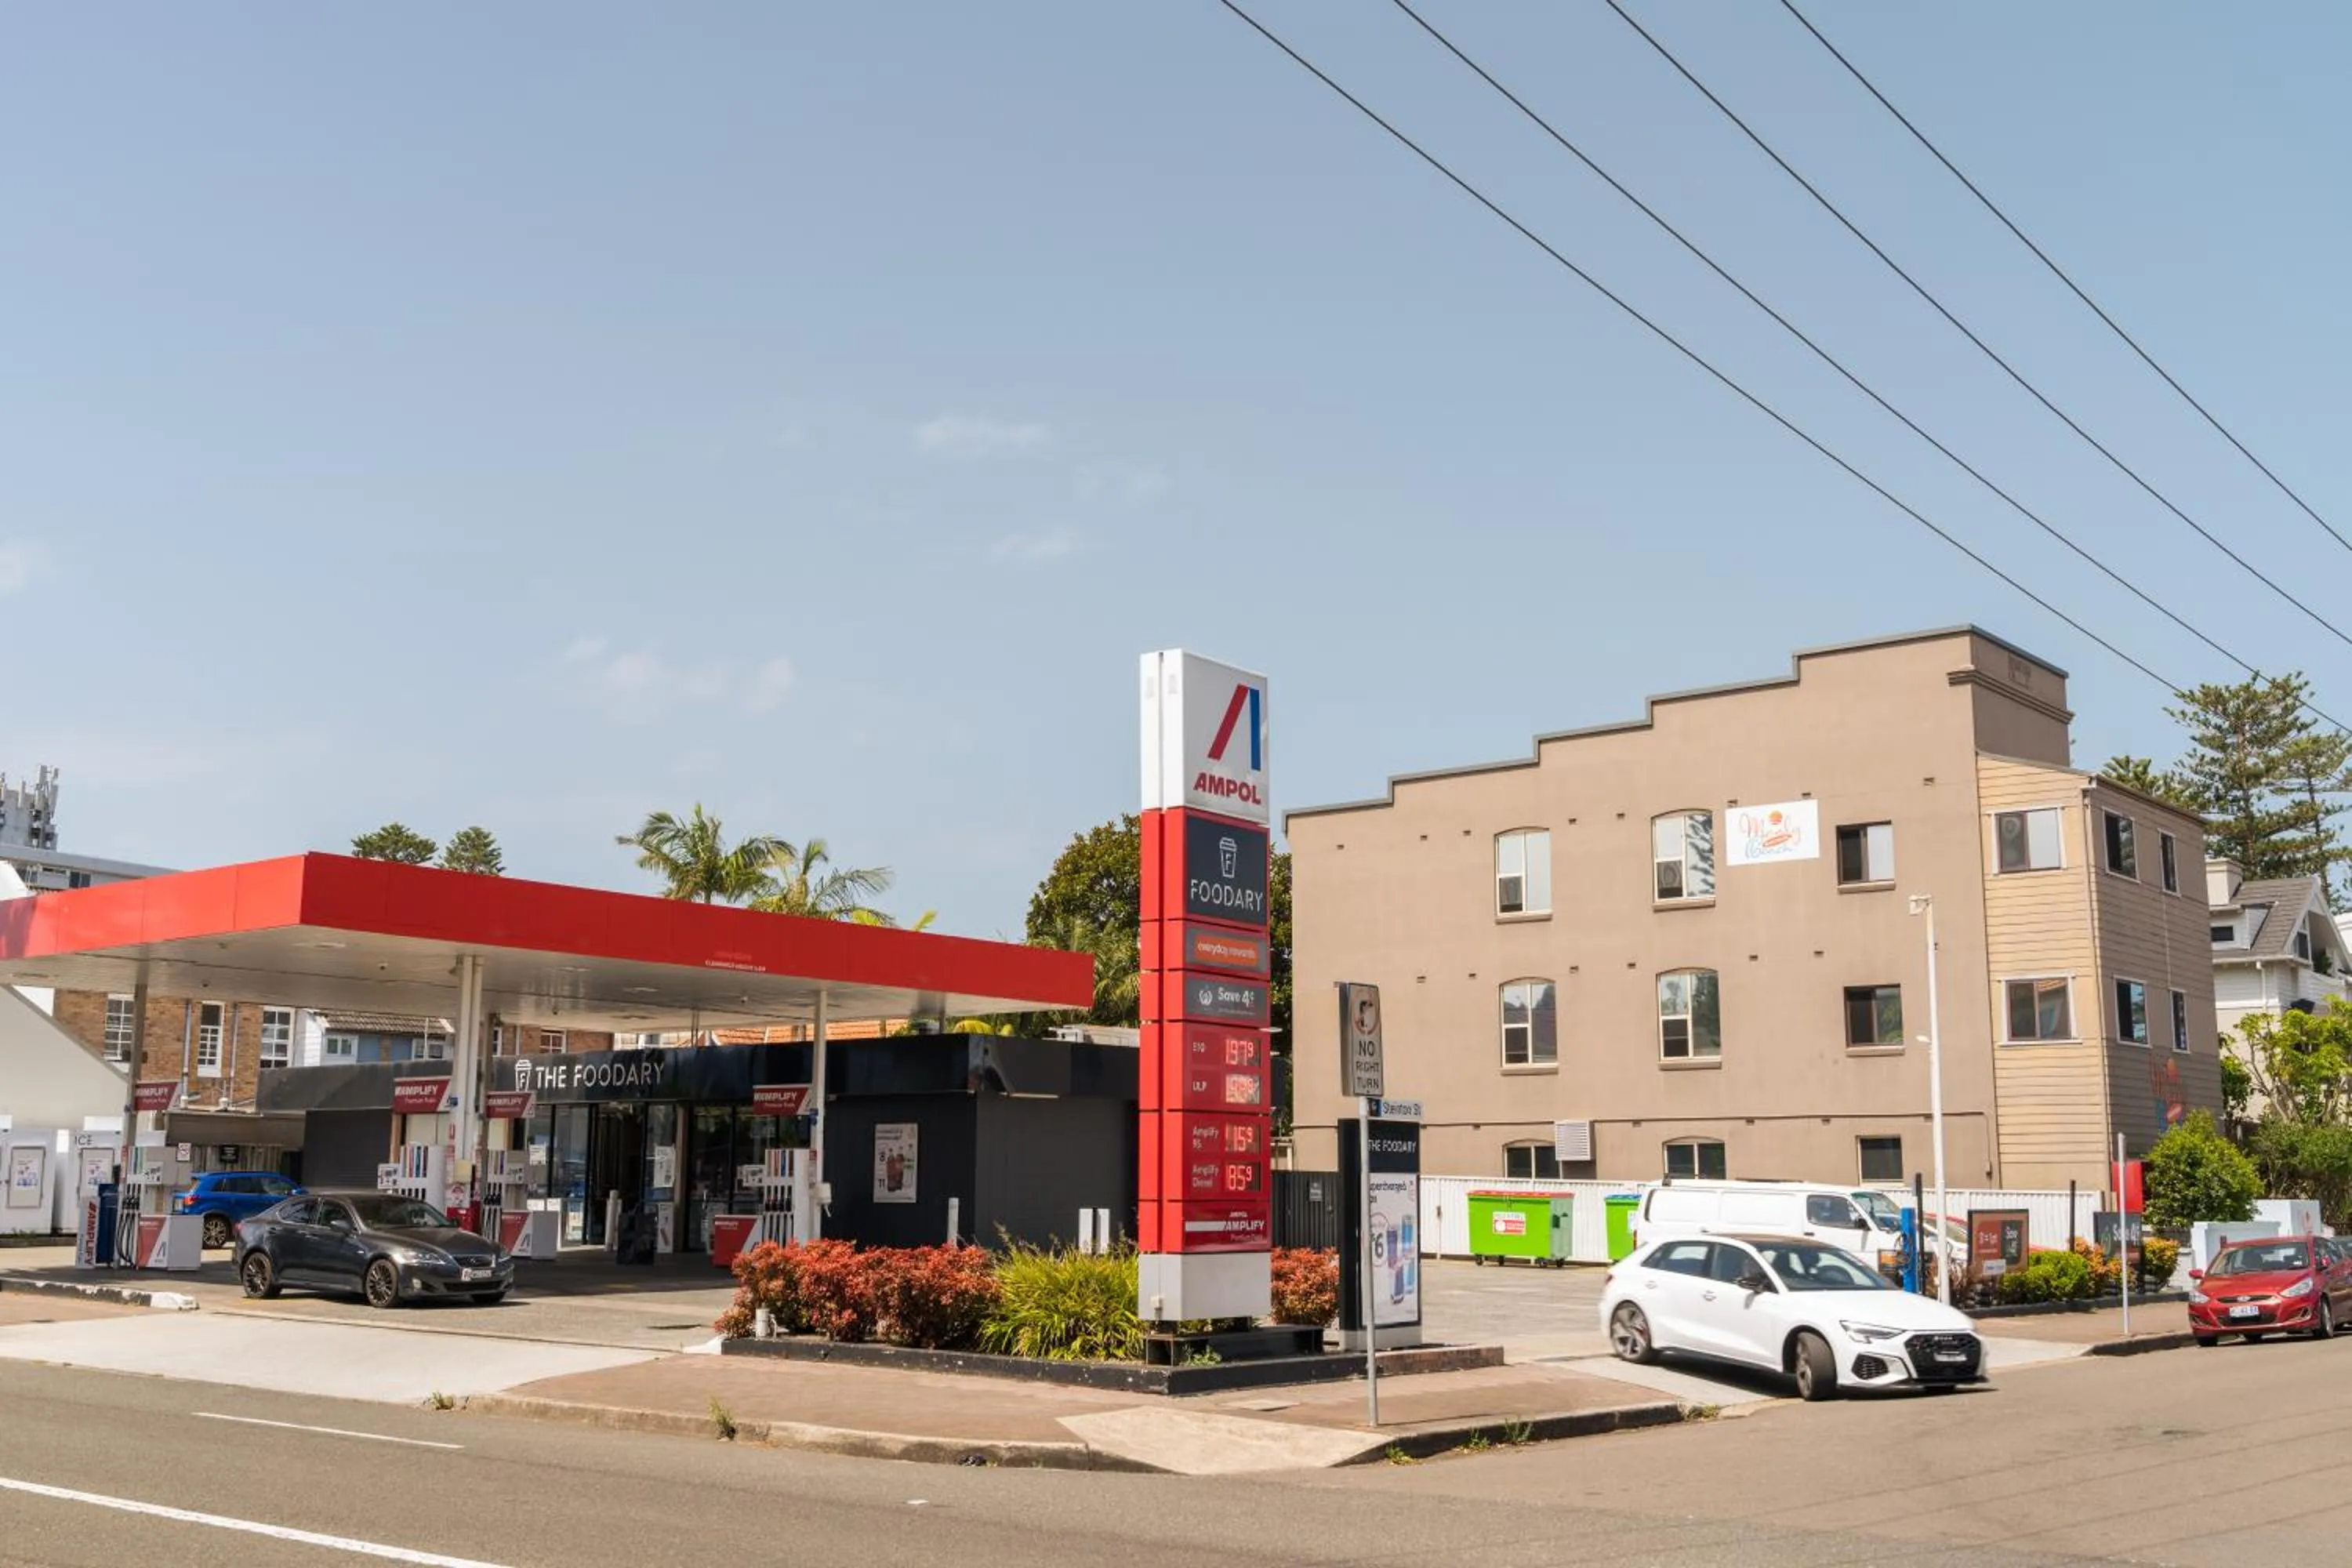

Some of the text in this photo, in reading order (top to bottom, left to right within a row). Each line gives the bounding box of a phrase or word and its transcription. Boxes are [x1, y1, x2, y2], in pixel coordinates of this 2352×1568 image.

[1193, 772, 1261, 804] AMPOL
[1191, 879, 1263, 912] FOODARY
[1218, 987, 1241, 1003] Save
[1359, 1040, 1375, 1057] NO
[1356, 1060, 1380, 1073] RIGHT
[535, 1062, 665, 1089] THE FOODARY
[1357, 1076, 1379, 1089] TURN
[138, 1087, 169, 1097] AMPLIFY
[399, 1085, 437, 1096] AMPLIFY
[759, 1091, 797, 1102] AMPLIFY
[74, 1134, 93, 1145] ICE
[1367, 1139, 1416, 1153] THE FOODARY
[1225, 1220, 1265, 1231] AMPLIFY
[84, 1212, 96, 1265] AMPLIFY
